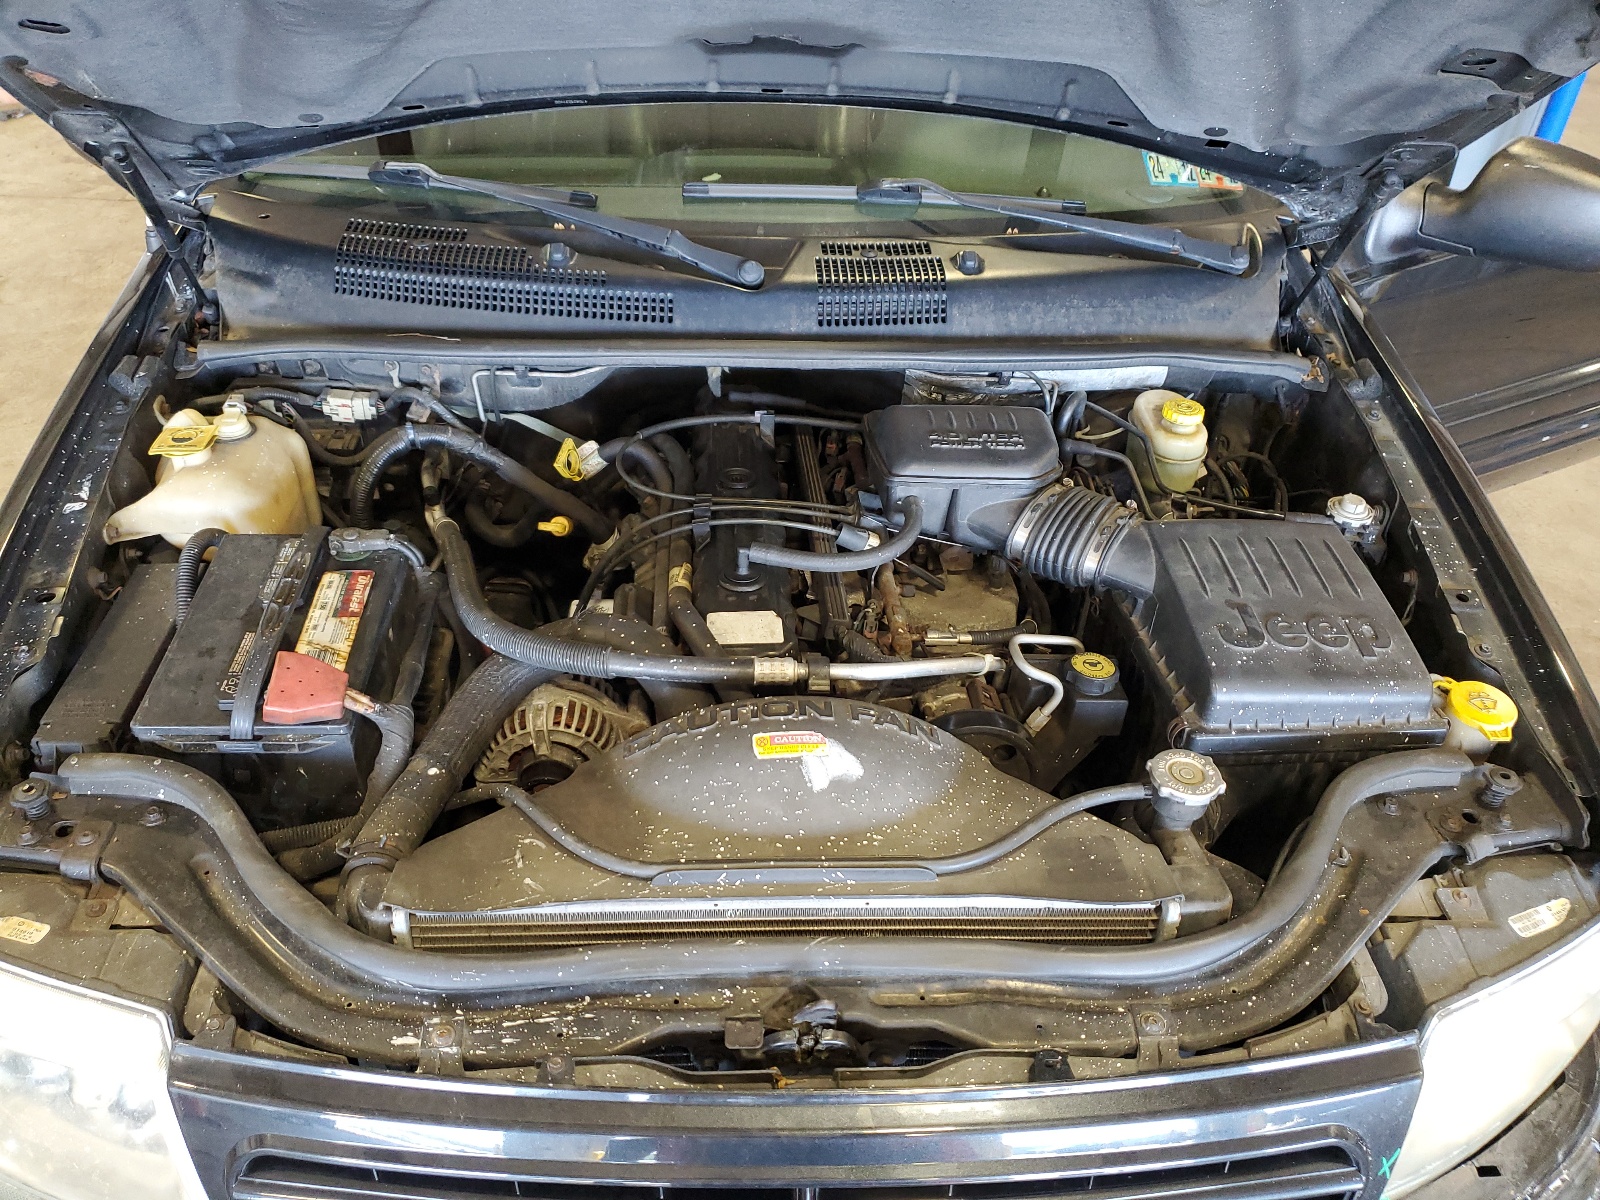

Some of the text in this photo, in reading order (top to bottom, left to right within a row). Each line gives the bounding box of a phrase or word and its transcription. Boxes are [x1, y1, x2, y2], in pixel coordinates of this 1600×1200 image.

[1148, 155, 1164, 179] 24
[348, 574, 371, 612] Duralast
[1216, 599, 1392, 659] Jeep
[774, 735, 821, 743] CAUTION
[852, 704, 942, 748] FAN
